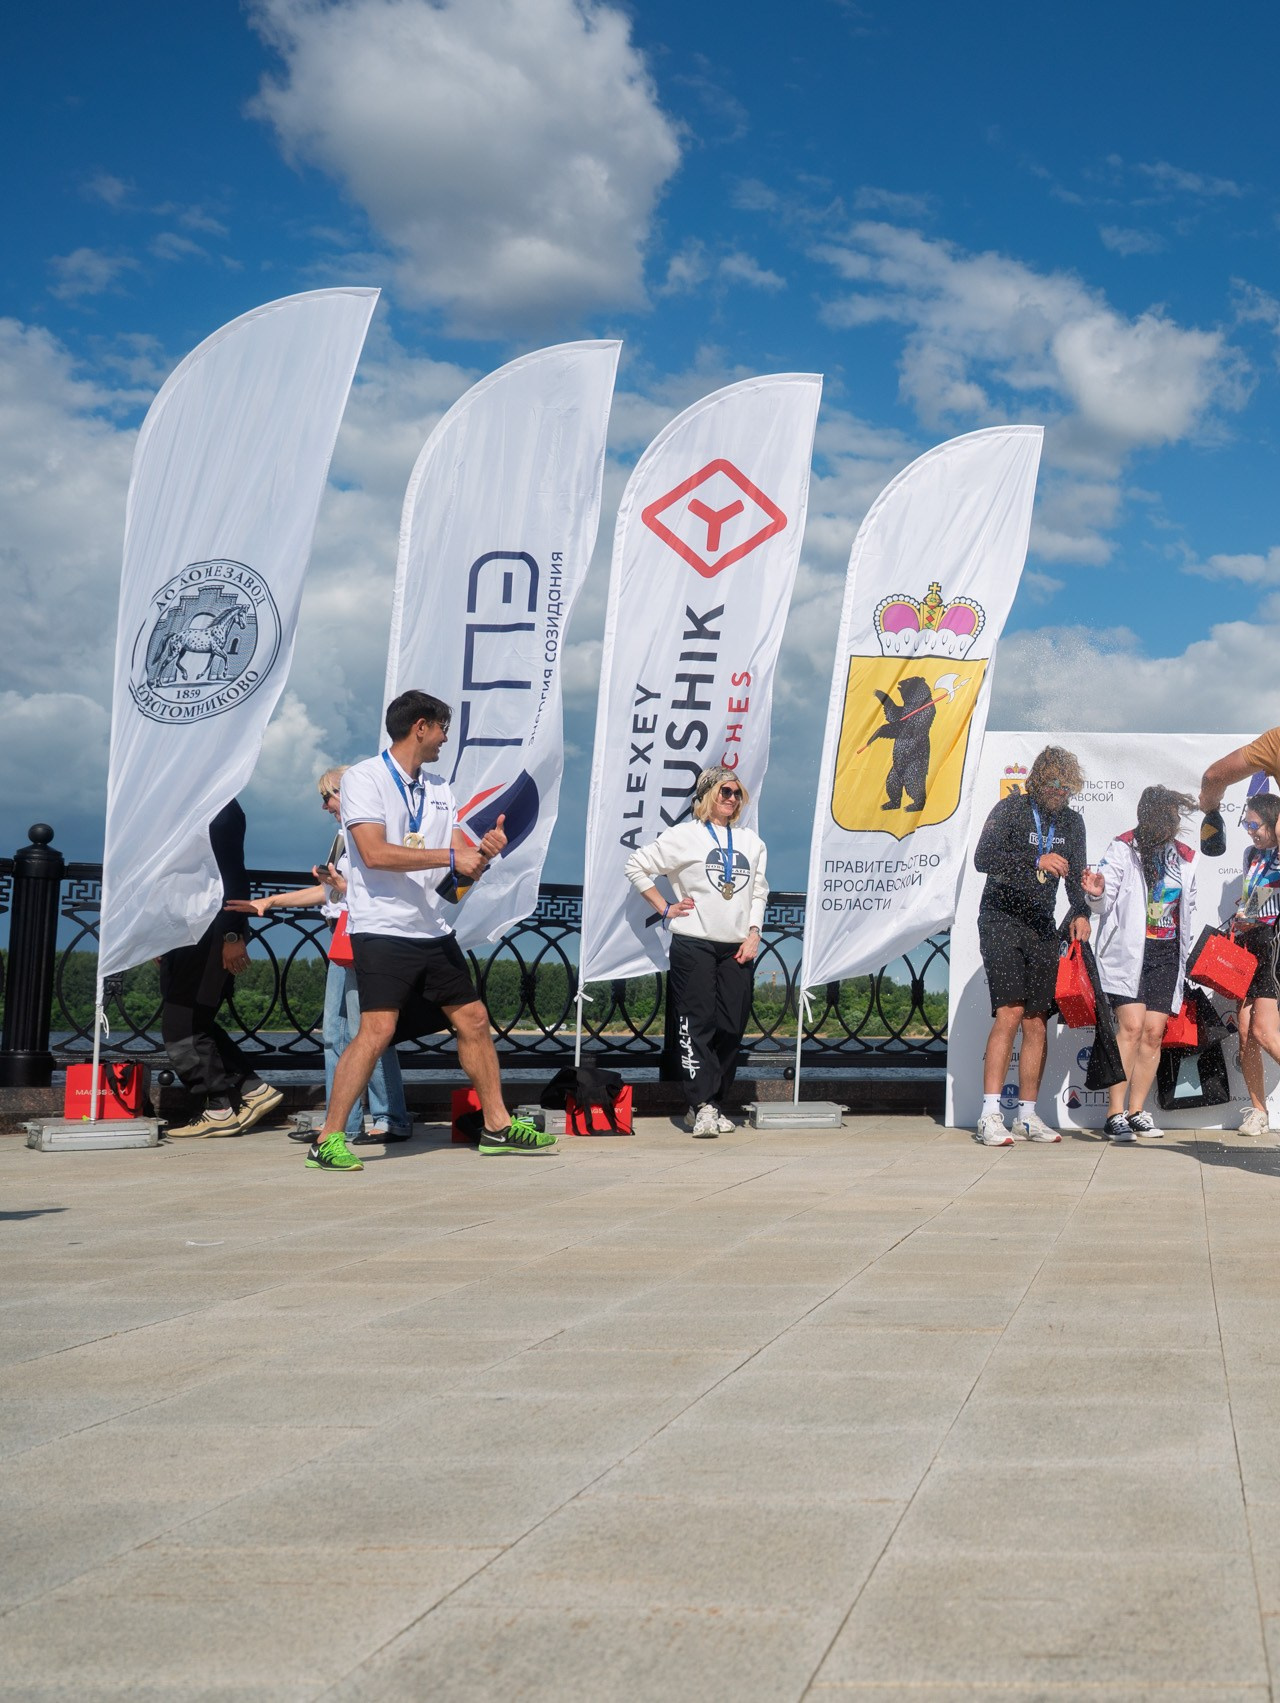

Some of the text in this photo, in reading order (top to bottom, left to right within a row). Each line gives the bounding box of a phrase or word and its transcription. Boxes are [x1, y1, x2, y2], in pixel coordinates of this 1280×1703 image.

[545, 551, 563, 663] созидания
[175, 689, 201, 700] 1859
[721, 671, 752, 770] CHES
[620, 683, 661, 850] ALEXEY
[645, 604, 725, 928] KUSHIK
[823, 871, 922, 892] ЯРОСЛАВСКОЙ
[824, 854, 940, 873] ПРАВИТЕЛЬСТВО
[821, 898, 892, 911] ОБЛАСТИ
